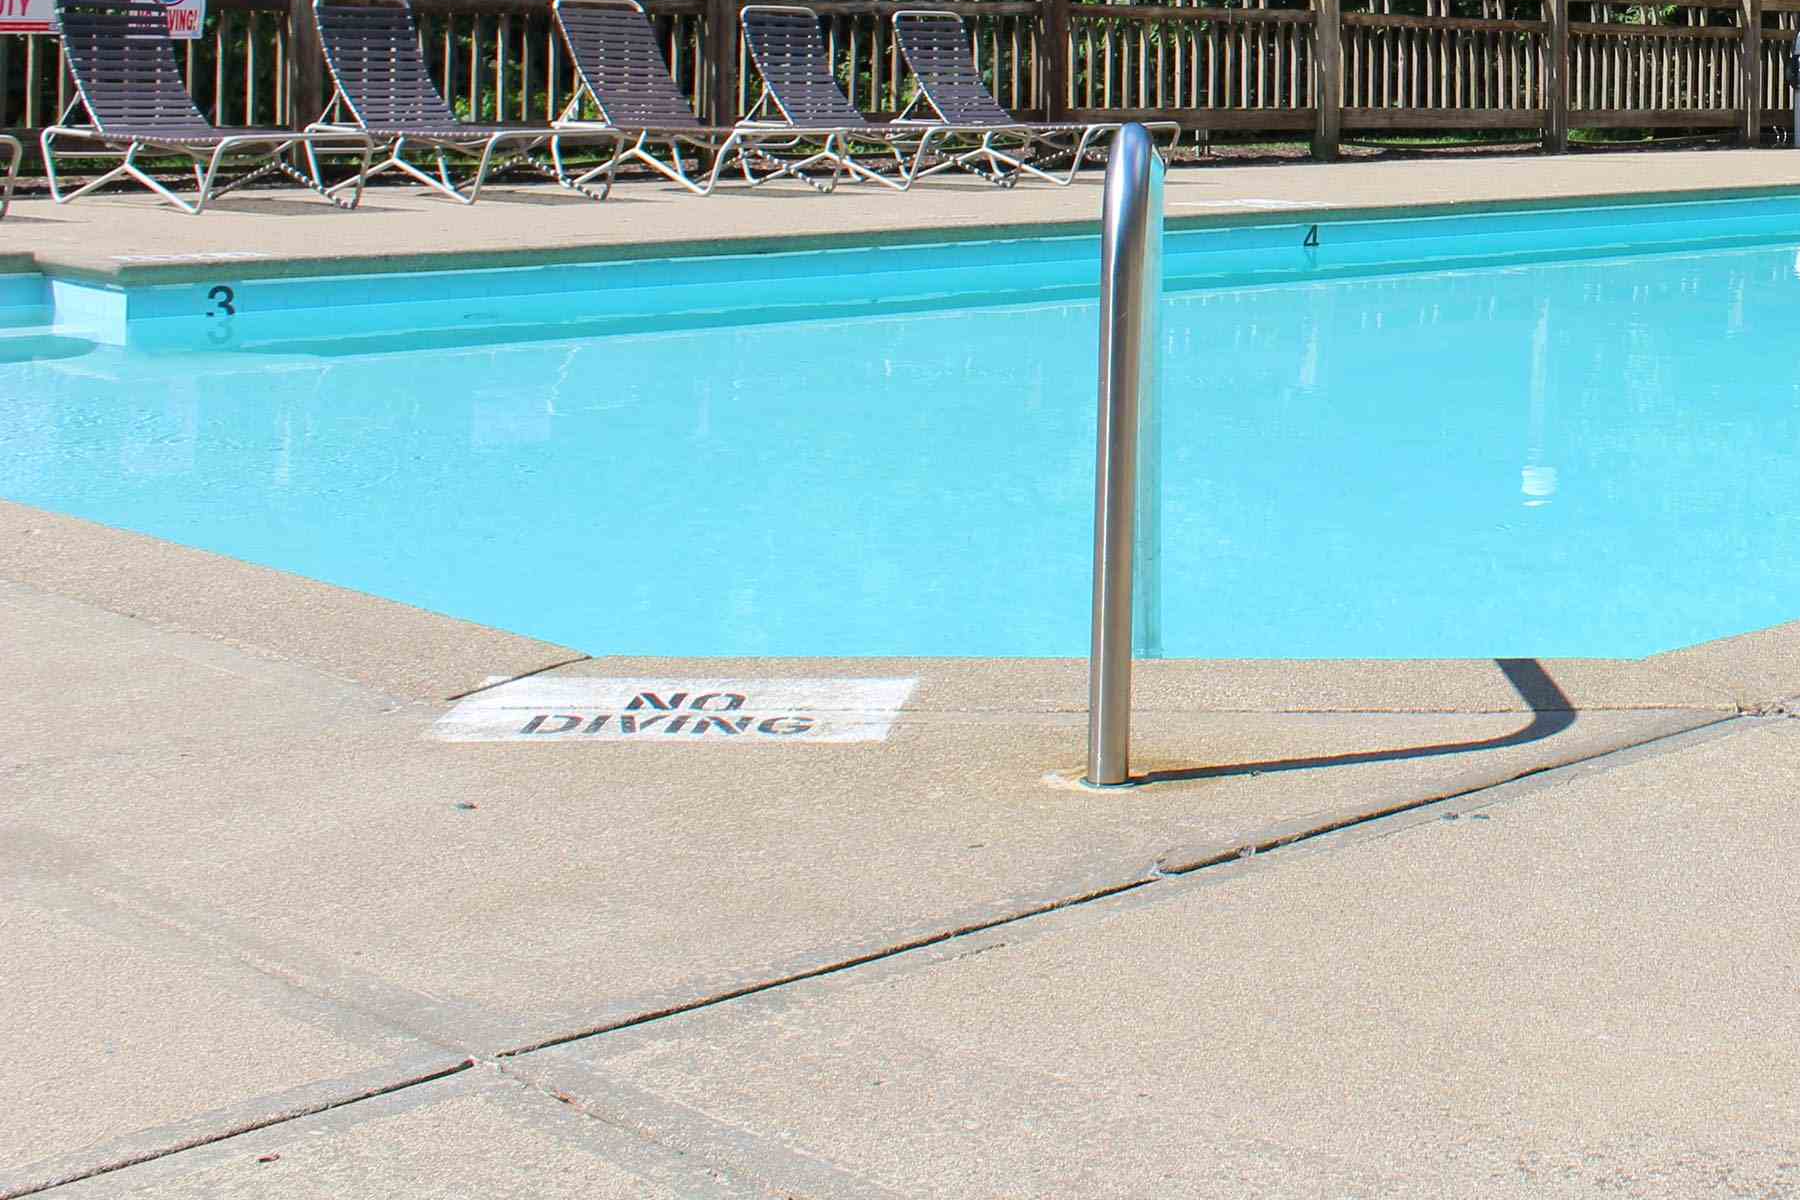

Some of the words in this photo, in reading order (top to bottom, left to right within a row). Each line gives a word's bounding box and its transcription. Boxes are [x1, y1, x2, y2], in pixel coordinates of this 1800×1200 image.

[1303, 224, 1320, 247] 4
[205, 285, 236, 317] 3
[625, 691, 748, 711] NO
[518, 714, 818, 736] DIVING
